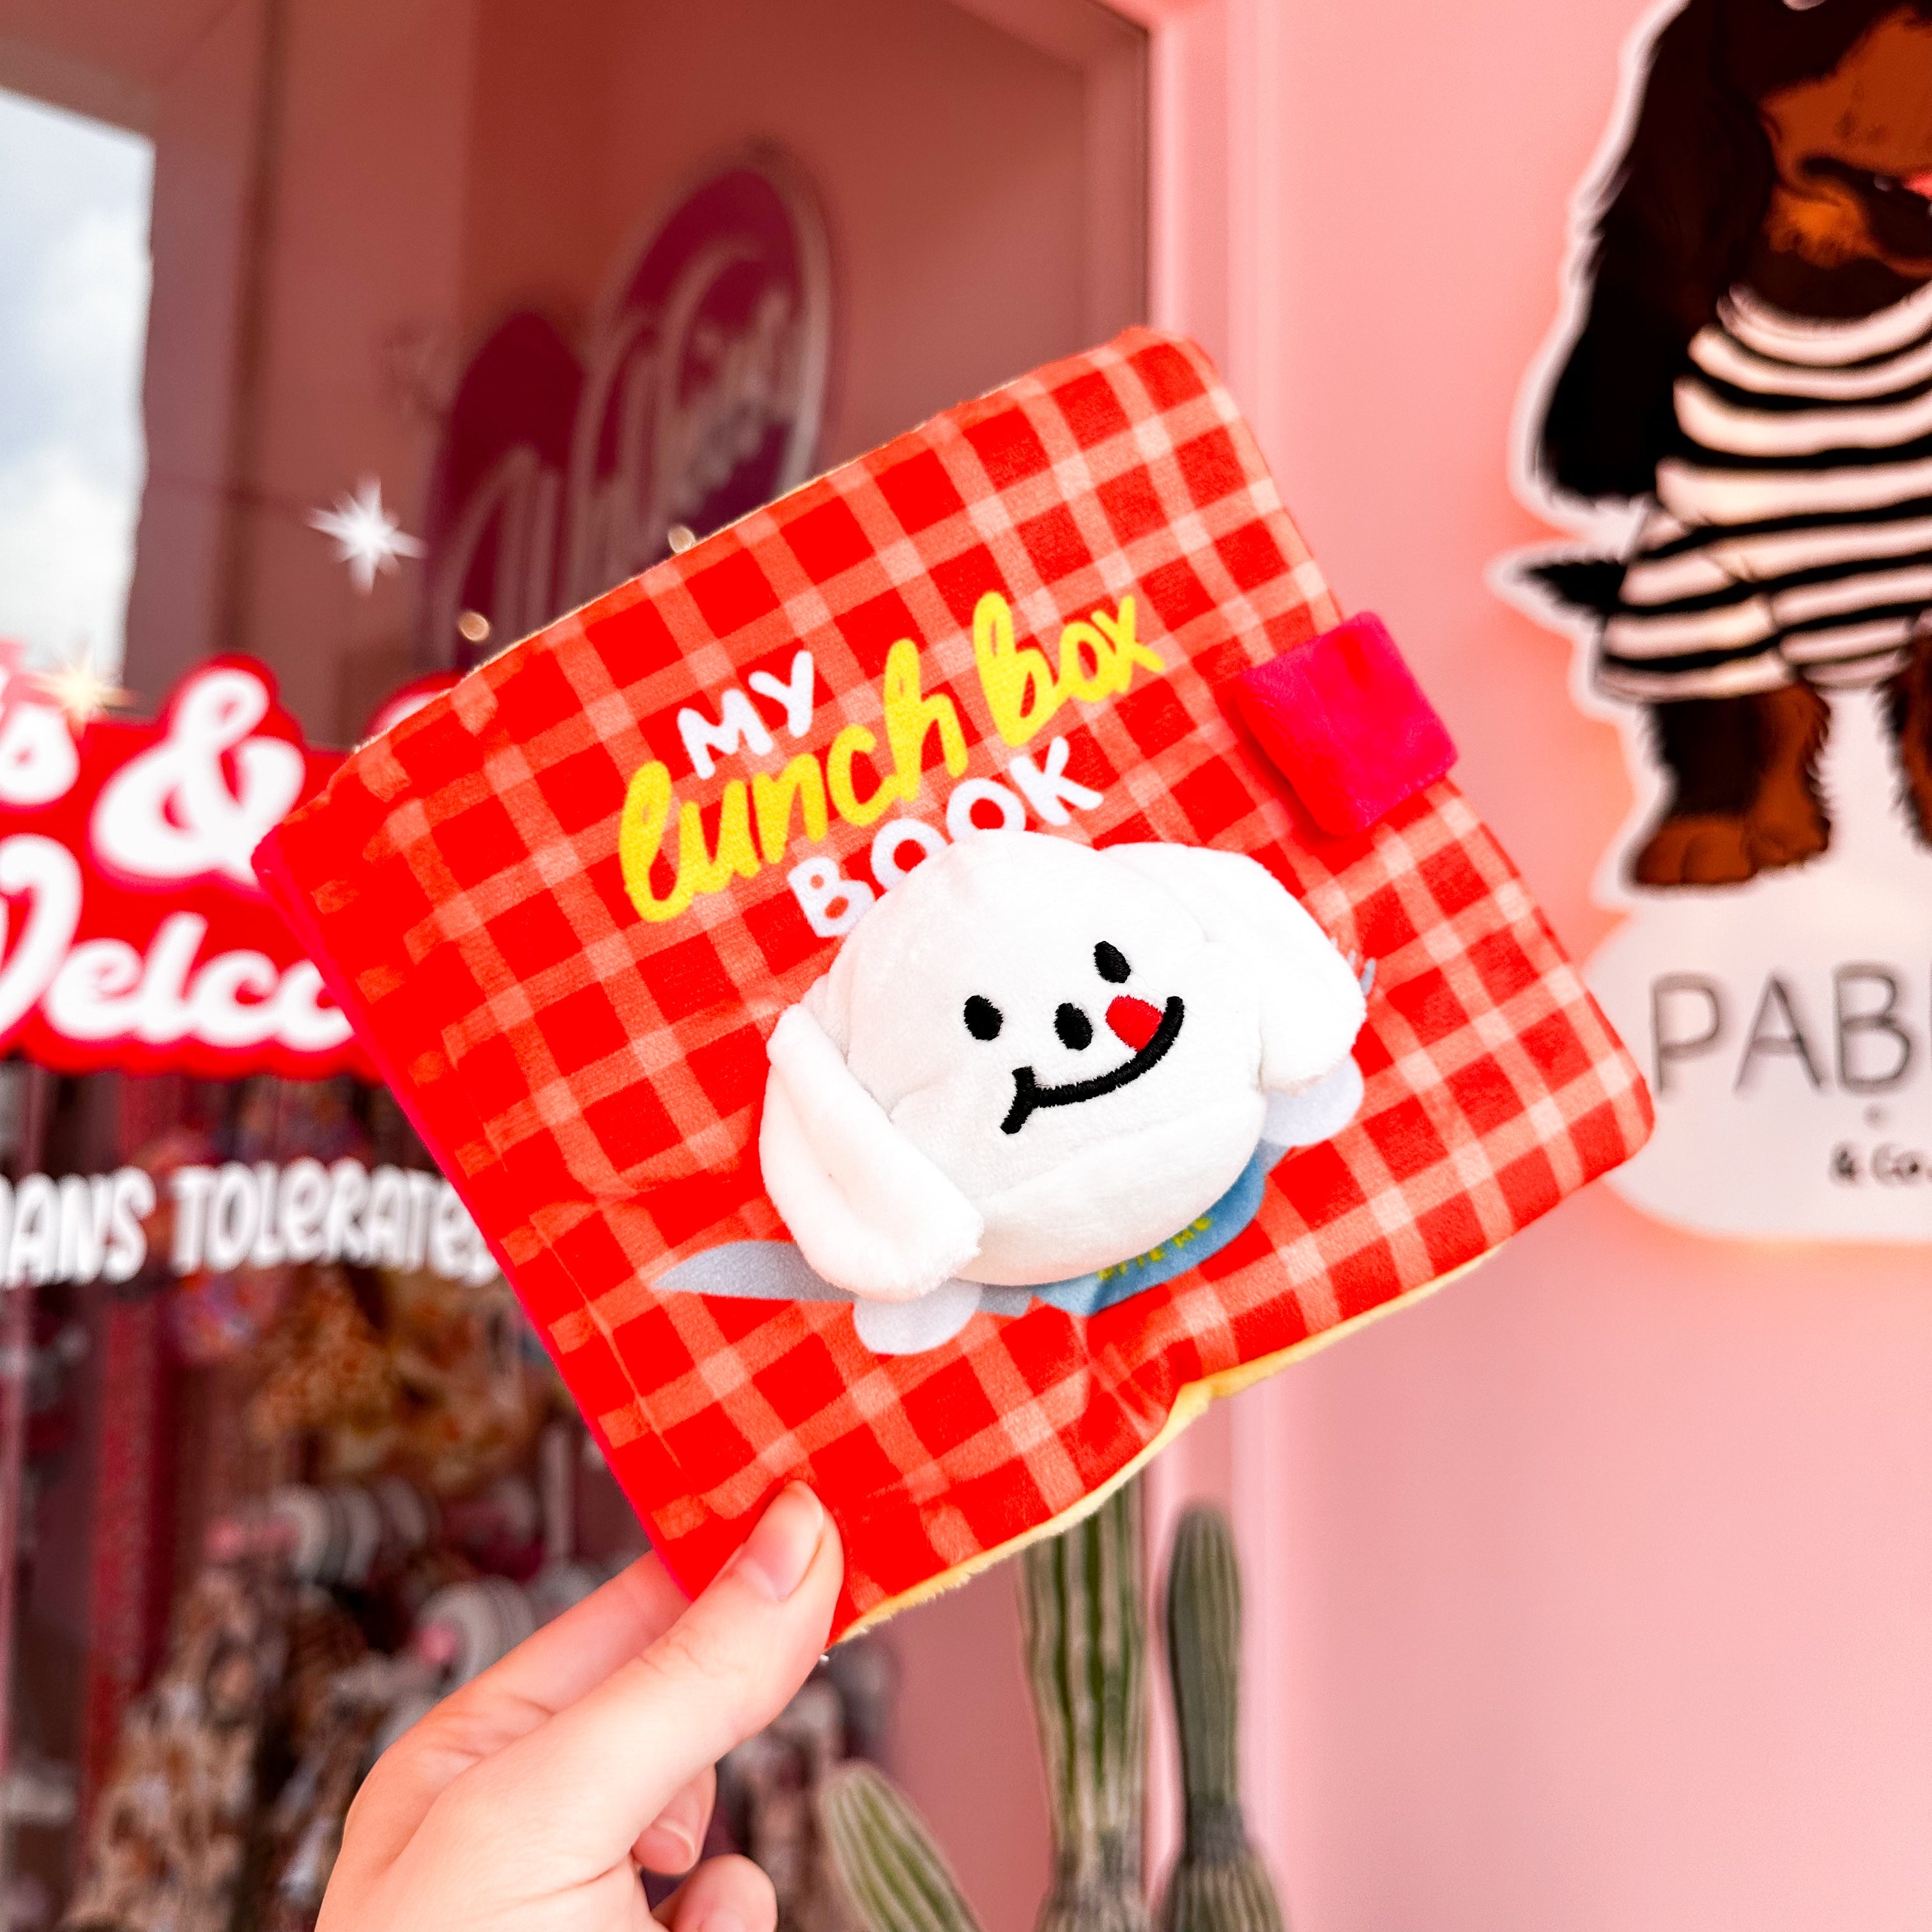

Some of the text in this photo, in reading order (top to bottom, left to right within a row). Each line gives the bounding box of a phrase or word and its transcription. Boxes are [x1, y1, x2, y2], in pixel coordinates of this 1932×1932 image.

[93, 668, 307, 882] &
[618, 592, 1165, 923] lunch box
[677, 650, 813, 779] MY
[786, 737, 1103, 938] BOOK
[1650, 961, 1932, 1096] PAB
[0, 1165, 156, 1288] ANS
